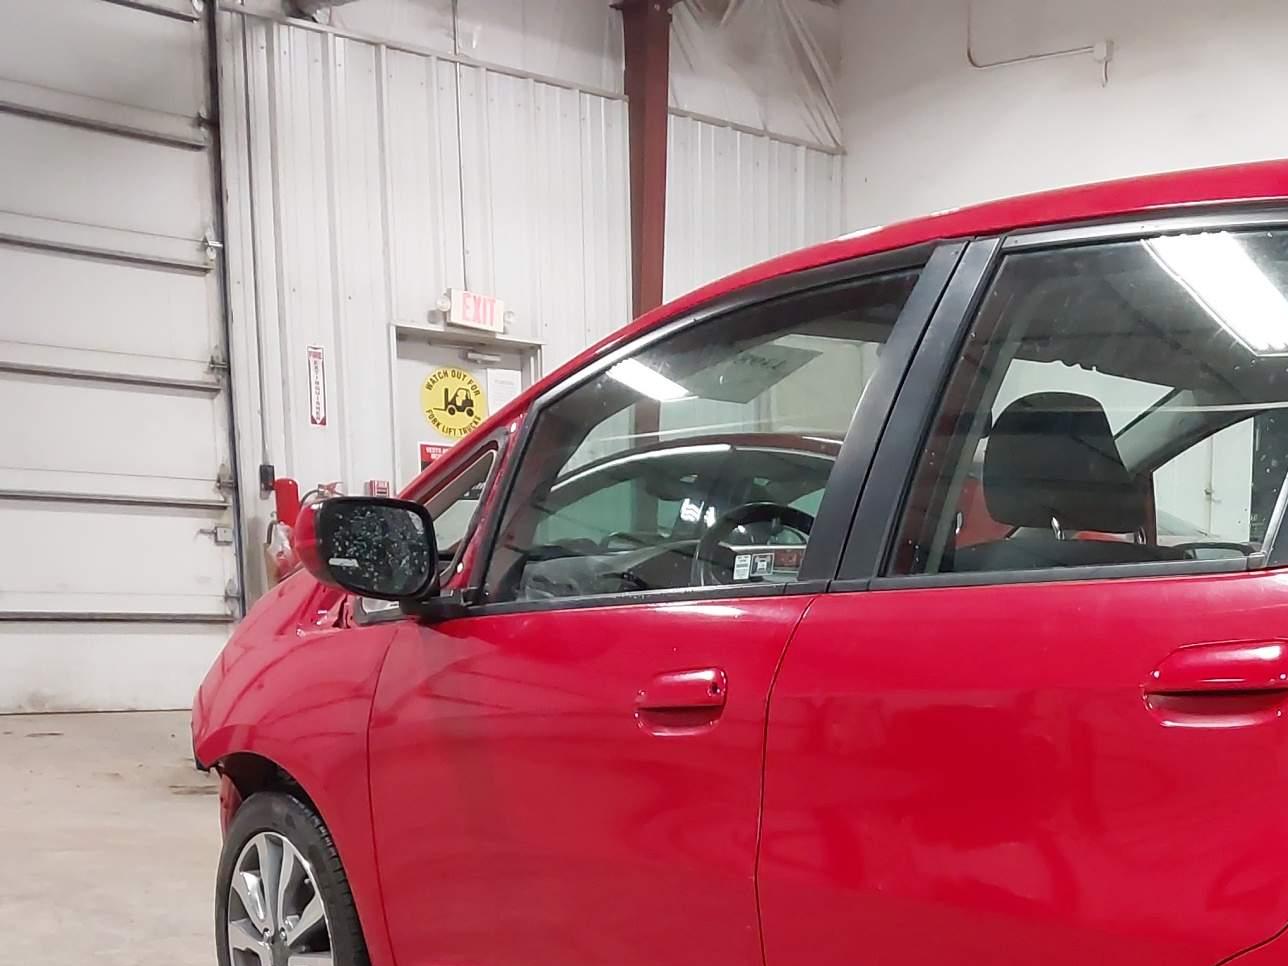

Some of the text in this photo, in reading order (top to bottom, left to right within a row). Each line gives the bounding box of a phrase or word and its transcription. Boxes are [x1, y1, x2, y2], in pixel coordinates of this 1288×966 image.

[463, 293, 496, 327] EXIT
[425, 370, 481, 396] WATCH OUT FOR
[426, 409, 442, 429] FORK
[442, 425, 457, 436] LIFT
